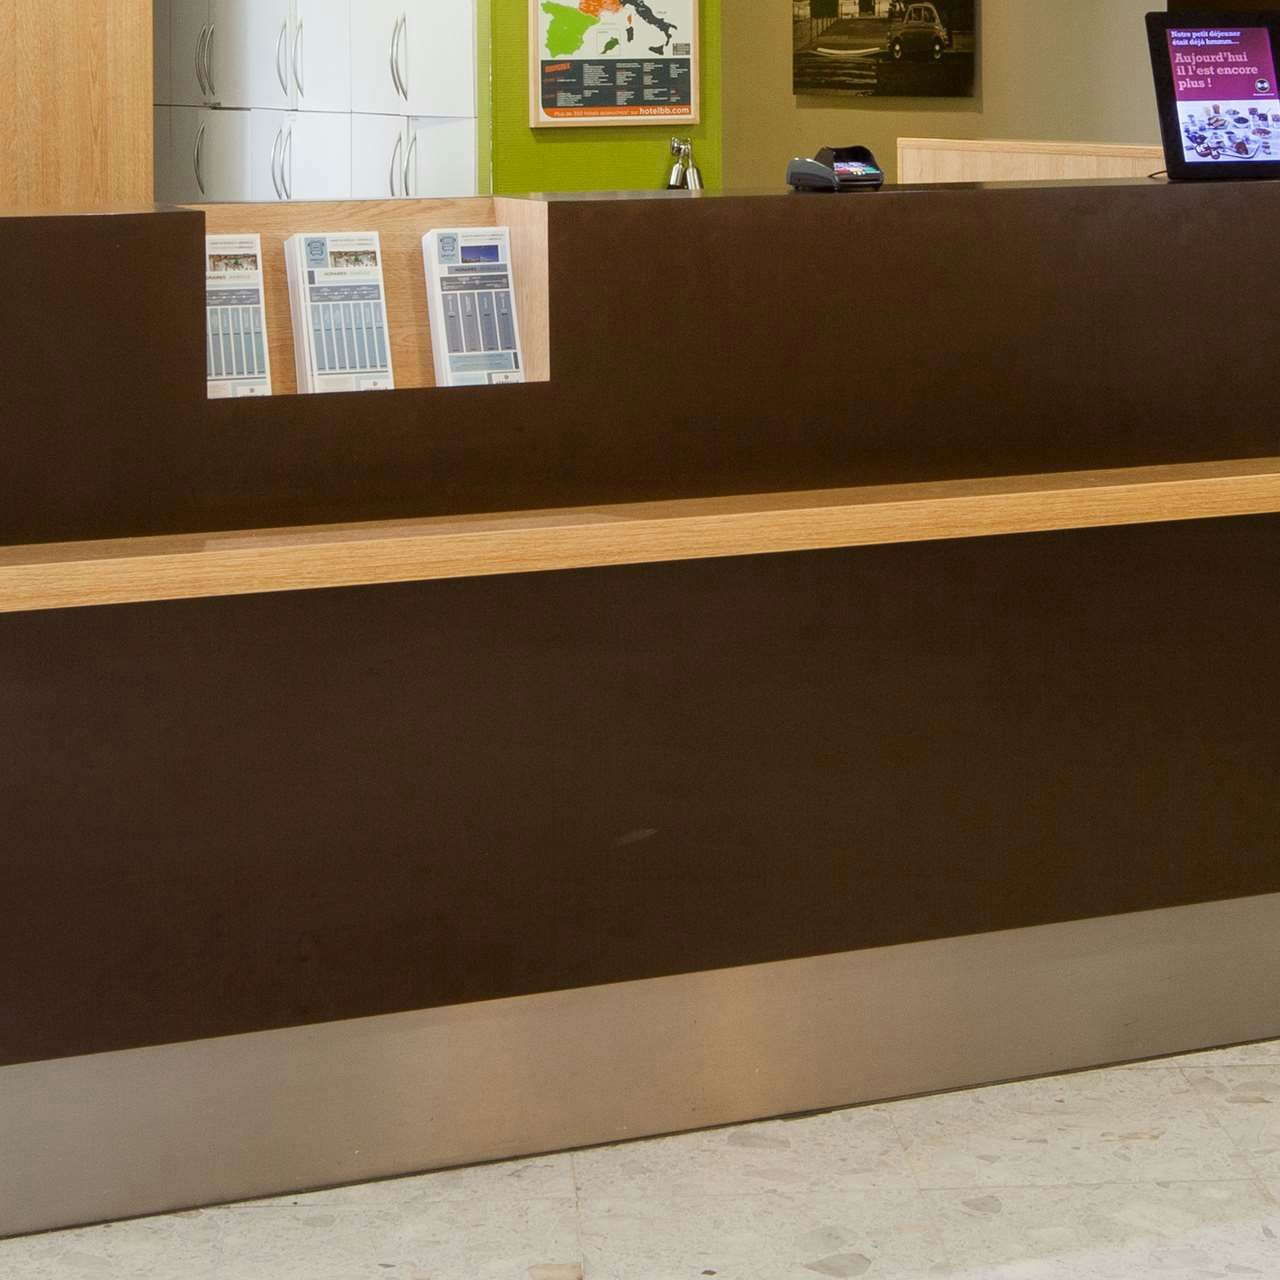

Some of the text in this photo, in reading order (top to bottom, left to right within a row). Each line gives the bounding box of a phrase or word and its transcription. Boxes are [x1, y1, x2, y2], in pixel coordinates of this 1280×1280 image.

[1175, 51, 1248, 65] Aujourd'hui
[1176, 65, 1258, 76] il l'est encore
[1178, 78, 1205, 91] plus
[639, 106, 690, 116] hotelbb.com
